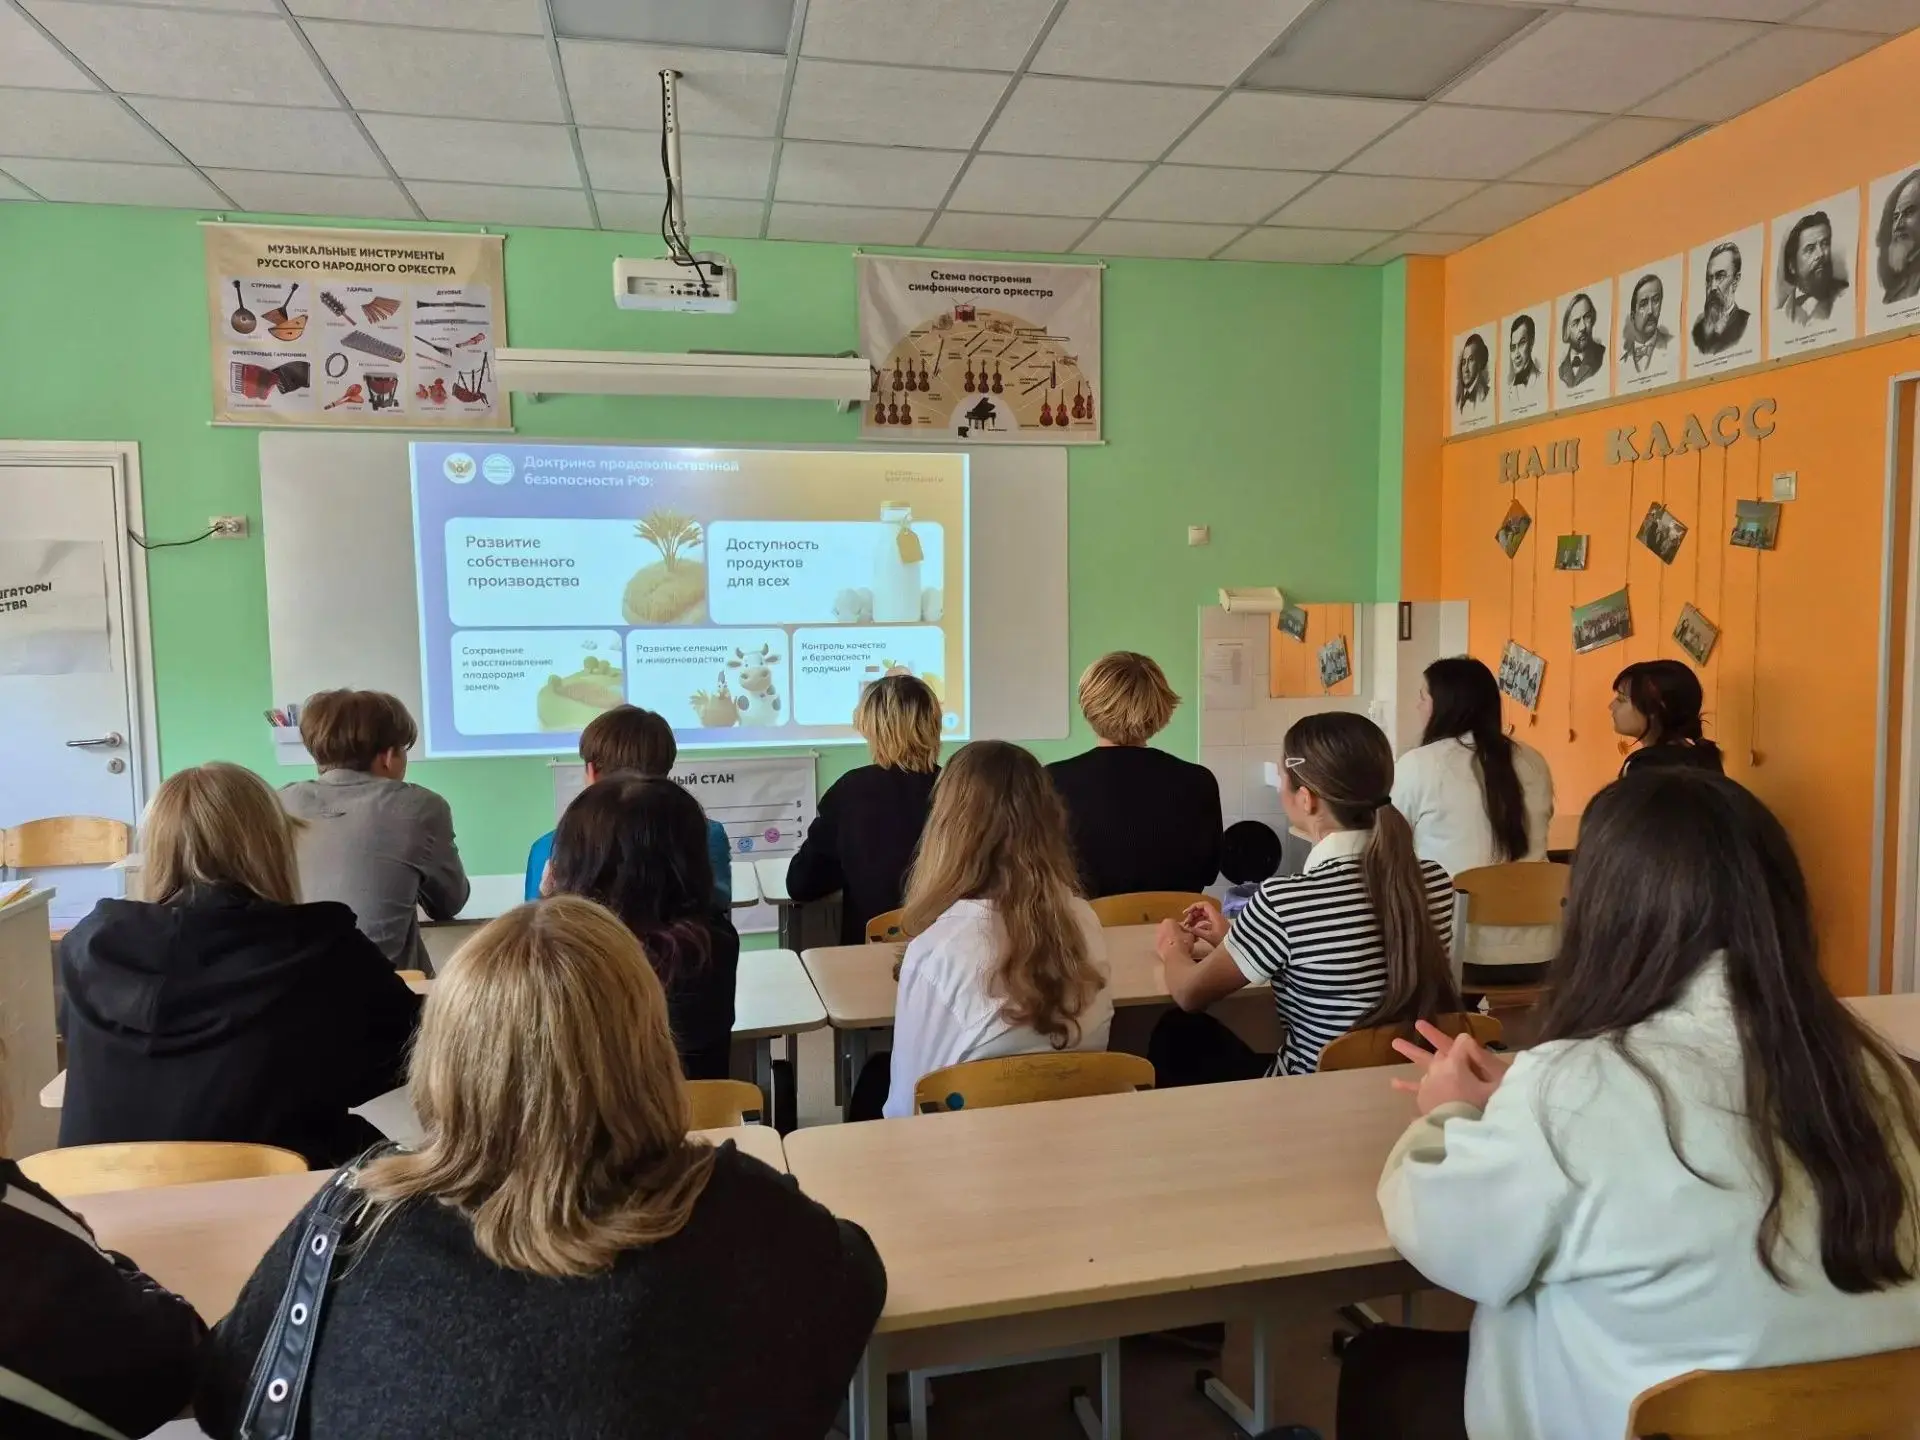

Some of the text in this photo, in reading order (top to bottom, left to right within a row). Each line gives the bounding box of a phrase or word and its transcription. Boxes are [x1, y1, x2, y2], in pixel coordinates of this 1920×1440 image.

[267, 244, 445, 261] МУЗЫКАЛЬНЫЕ ИНСТРУМЕНТЫ
[257, 258, 456, 275] РУССКОГО НАРОДНОГО ОРКЕСТРА
[930, 270, 1032, 285] Схема построения
[908, 282, 1054, 298] симфонического оркестра
[1499, 398, 1777, 484] НАШ КЛАСС
[524, 455, 740, 472] Доктрина продовольственной
[524, 472, 654, 487] безопасности РФ:
[465, 536, 541, 549] Развитие
[726, 538, 819, 553] Доступность
[467, 555, 575, 568] собственного
[726, 558, 804, 571] продуктов
[467, 575, 580, 590] производства
[726, 576, 790, 588] для всех
[462, 646, 524, 656] Сохранение
[636, 644, 682, 653] Развитие
[801, 642, 845, 651] Контроль
[700, 773, 735, 785] СТАН
